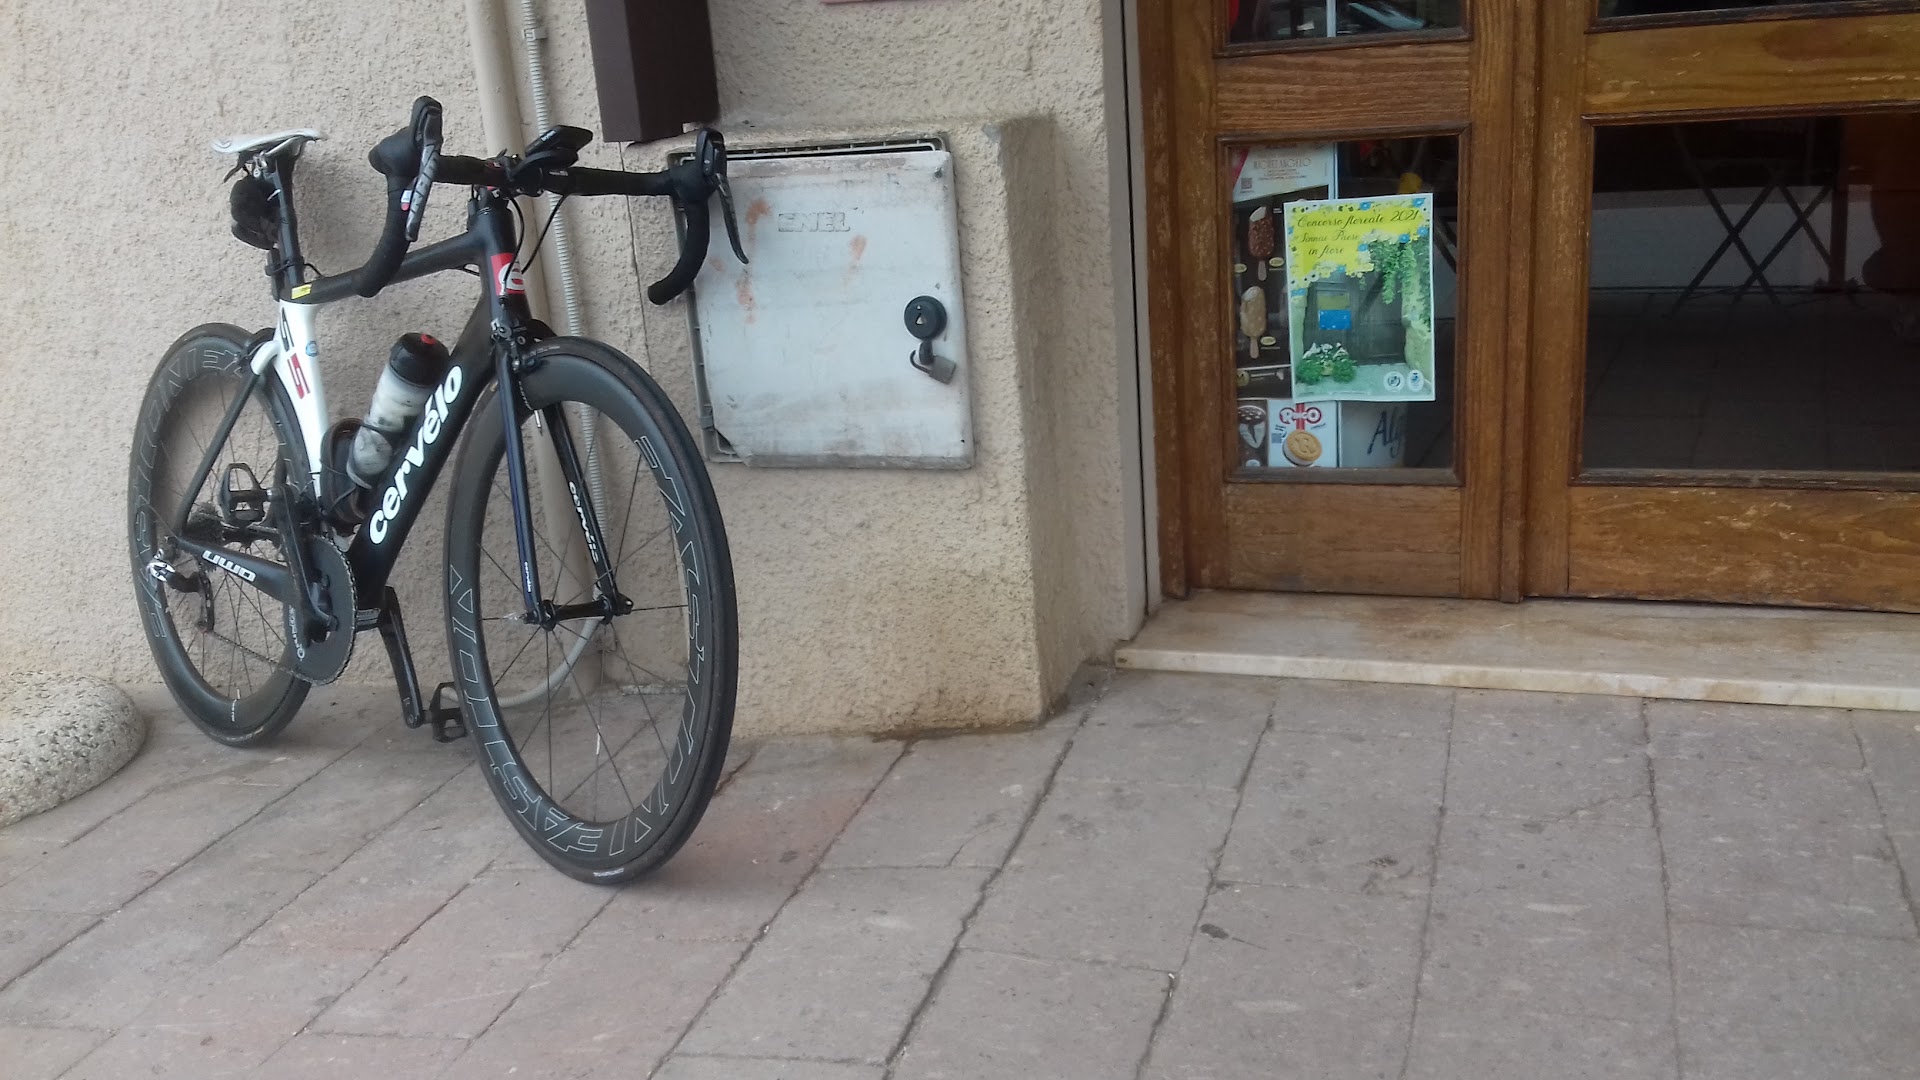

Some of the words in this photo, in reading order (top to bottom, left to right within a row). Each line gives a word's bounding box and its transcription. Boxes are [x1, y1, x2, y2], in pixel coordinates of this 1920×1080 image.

[778, 211, 851, 232] ENEL
[1297, 216, 1343, 229] Concorso
[1390, 208, 1420, 222] 2021
